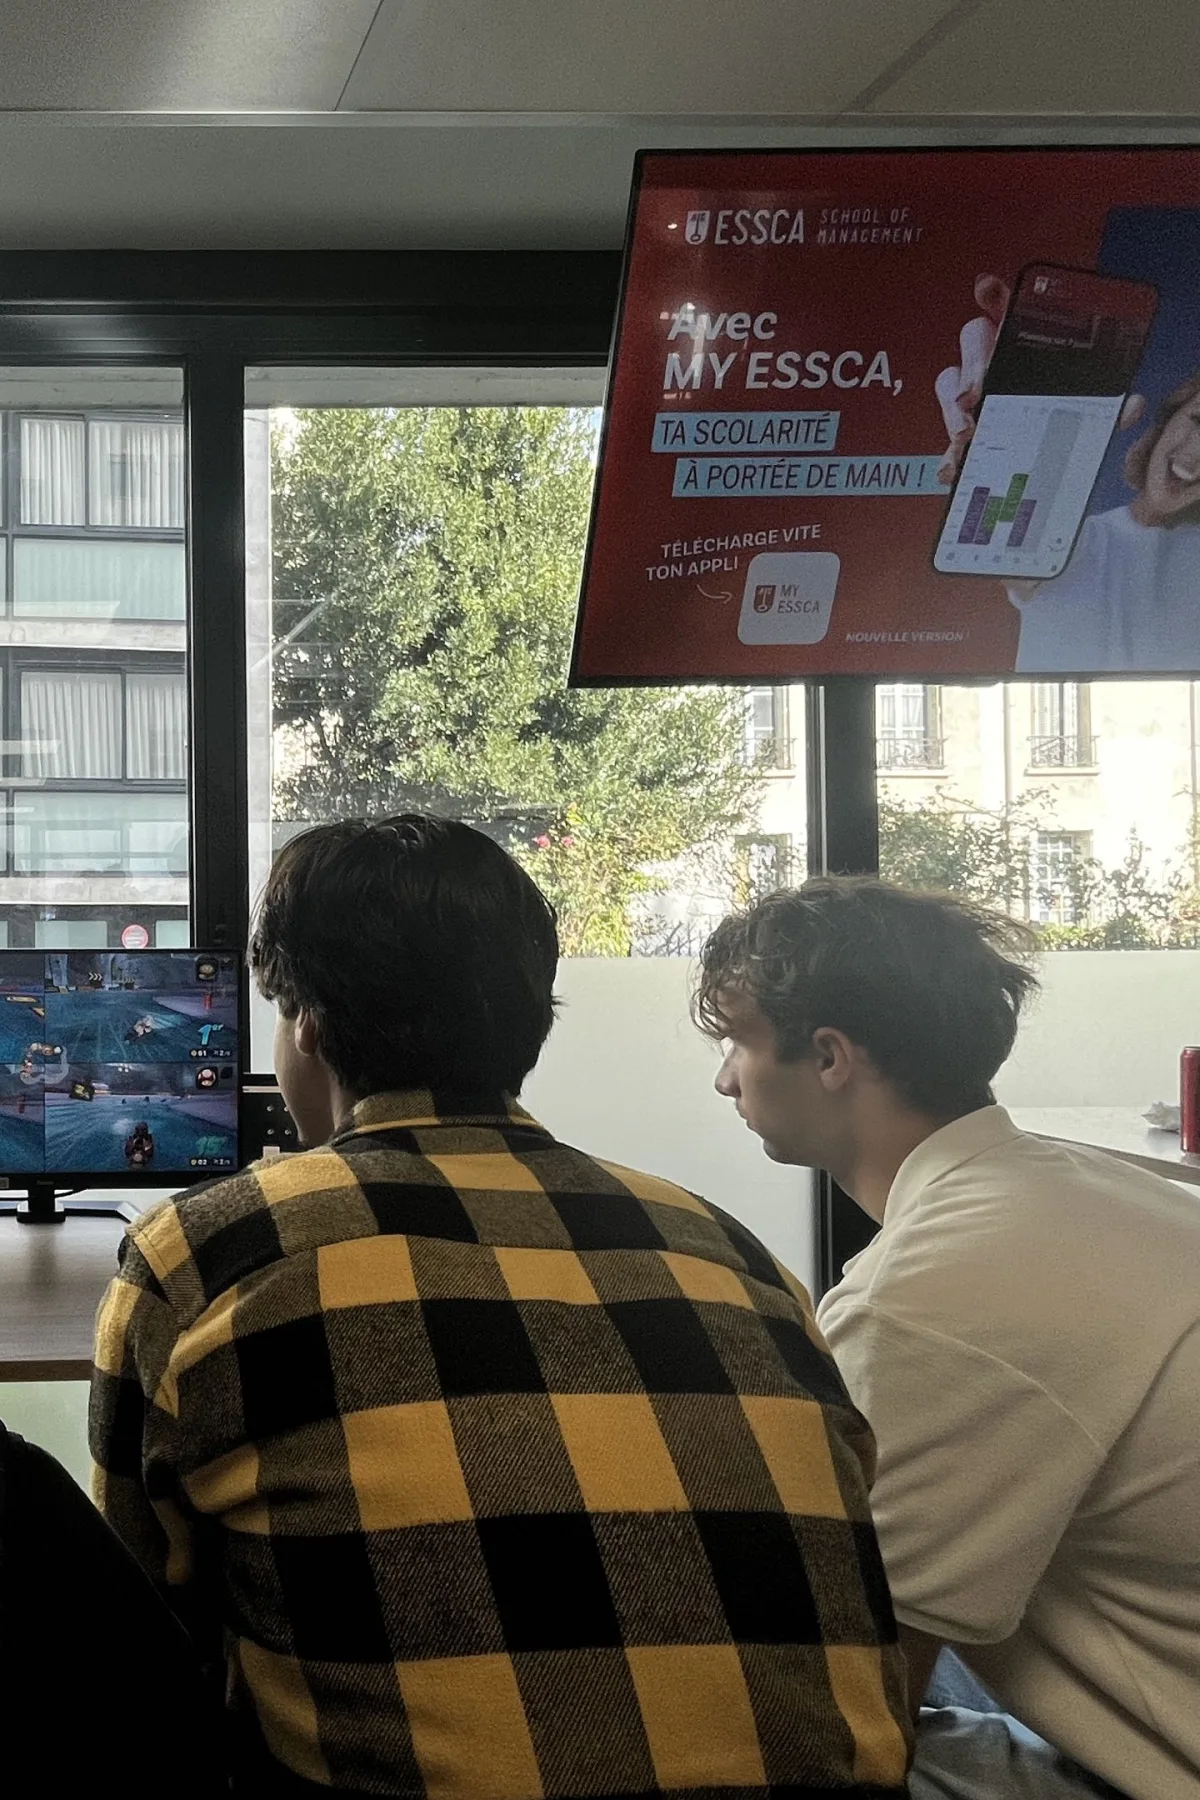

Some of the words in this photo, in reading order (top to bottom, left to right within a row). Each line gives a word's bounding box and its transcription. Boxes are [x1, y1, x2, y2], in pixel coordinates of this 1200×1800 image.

[714, 208, 804, 244] ESSCA
[820, 208, 881, 224] SCHOOL
[889, 207, 910, 223] OF
[816, 227, 924, 244] MANAGEMENT
[667, 305, 777, 340] Avec
[663, 352, 737, 390] MY
[746, 350, 903, 396] ESSCA,
[660, 419, 687, 445] TA
[694, 412, 830, 445] SCOLARITÉ
[683, 460, 699, 489] À
[706, 459, 799, 489] PORTÉE
[807, 463, 838, 488] DE
[844, 463, 908, 488] MAIN
[661, 528, 779, 558] TÉLÉCHARGE
[782, 524, 821, 543] VITE
[645, 561, 683, 581] TON
[685, 556, 739, 577] APPLI
[780, 584, 800, 597] MY
[777, 600, 820, 615] ESSCA
[845, 632, 908, 642] NOUVELLE
[911, 631, 963, 641] VERSION
